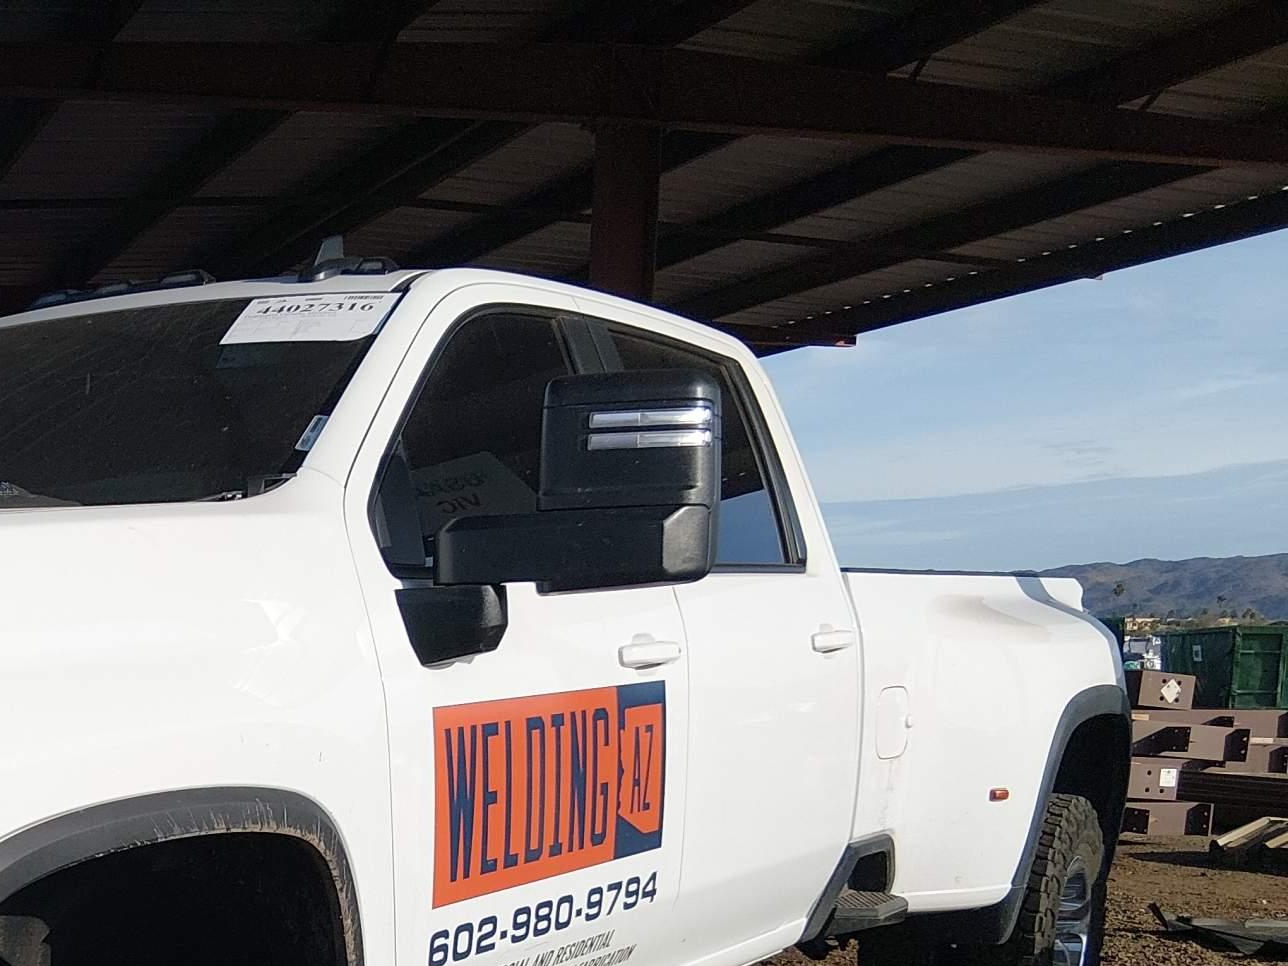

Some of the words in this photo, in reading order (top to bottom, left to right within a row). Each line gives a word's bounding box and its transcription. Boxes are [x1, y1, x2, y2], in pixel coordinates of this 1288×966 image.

[257, 302, 374, 315] 44027316
[444, 707, 610, 883] WELDING
[629, 724, 654, 815] AZ
[552, 929, 615, 966] RESIDENTIAL
